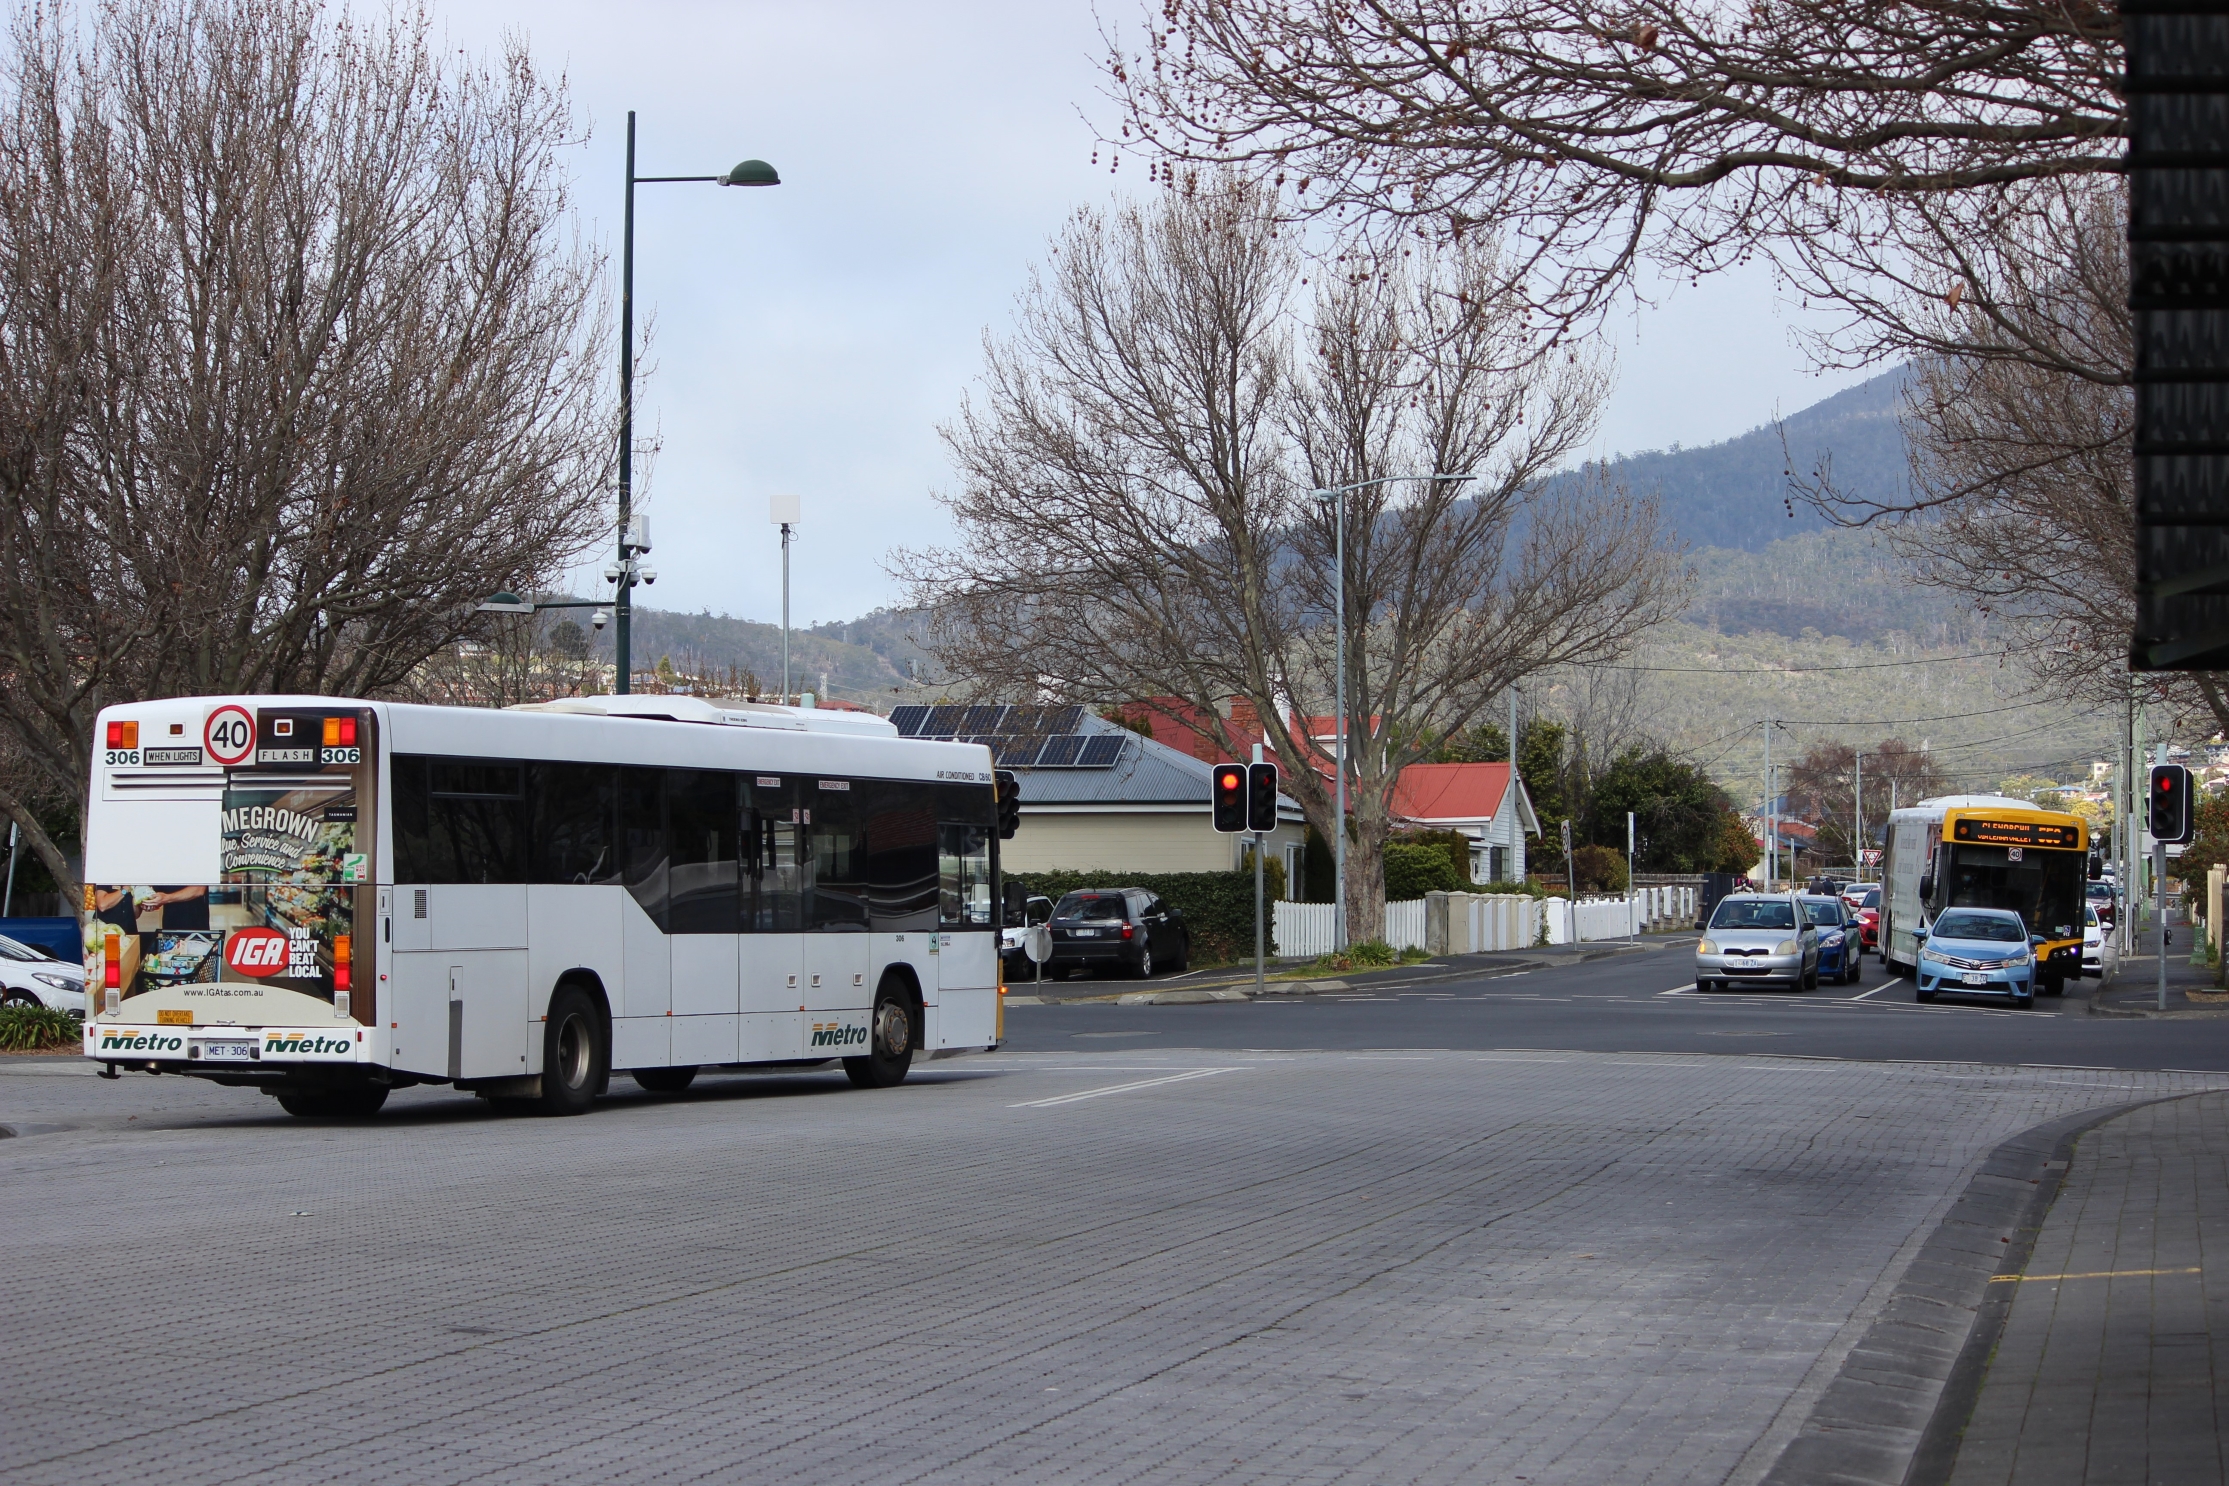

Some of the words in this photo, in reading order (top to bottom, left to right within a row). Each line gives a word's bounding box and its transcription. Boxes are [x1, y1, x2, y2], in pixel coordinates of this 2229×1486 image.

[212, 720, 247, 748] 40
[105, 751, 140, 765] 306
[148, 751, 171, 761] WHEN
[173, 751, 198, 761] LIGHTS
[262, 750, 310, 760] FLASH
[321, 749, 360, 763] 306
[936, 771, 944, 779] AIR
[946, 771, 974, 780] CONDITIONED
[221, 806, 319, 843] MEGROWN
[220, 838, 240, 854] lue,
[241, 832, 280, 851] Service
[280, 842, 304, 859] and
[225, 850, 286, 870] Convenience
[289, 927, 310, 940] YOU
[231, 938, 286, 965] IGA
[289, 940, 320, 952] CAN'T
[289, 952, 316, 965] BEAT
[289, 966, 322, 978] LOCAL
[184, 988, 264, 996] www.IGAtas.com.au
[101, 1030, 182, 1051] Metro
[811, 1023, 868, 1046] Metro
[265, 1033, 350, 1054] Metro
